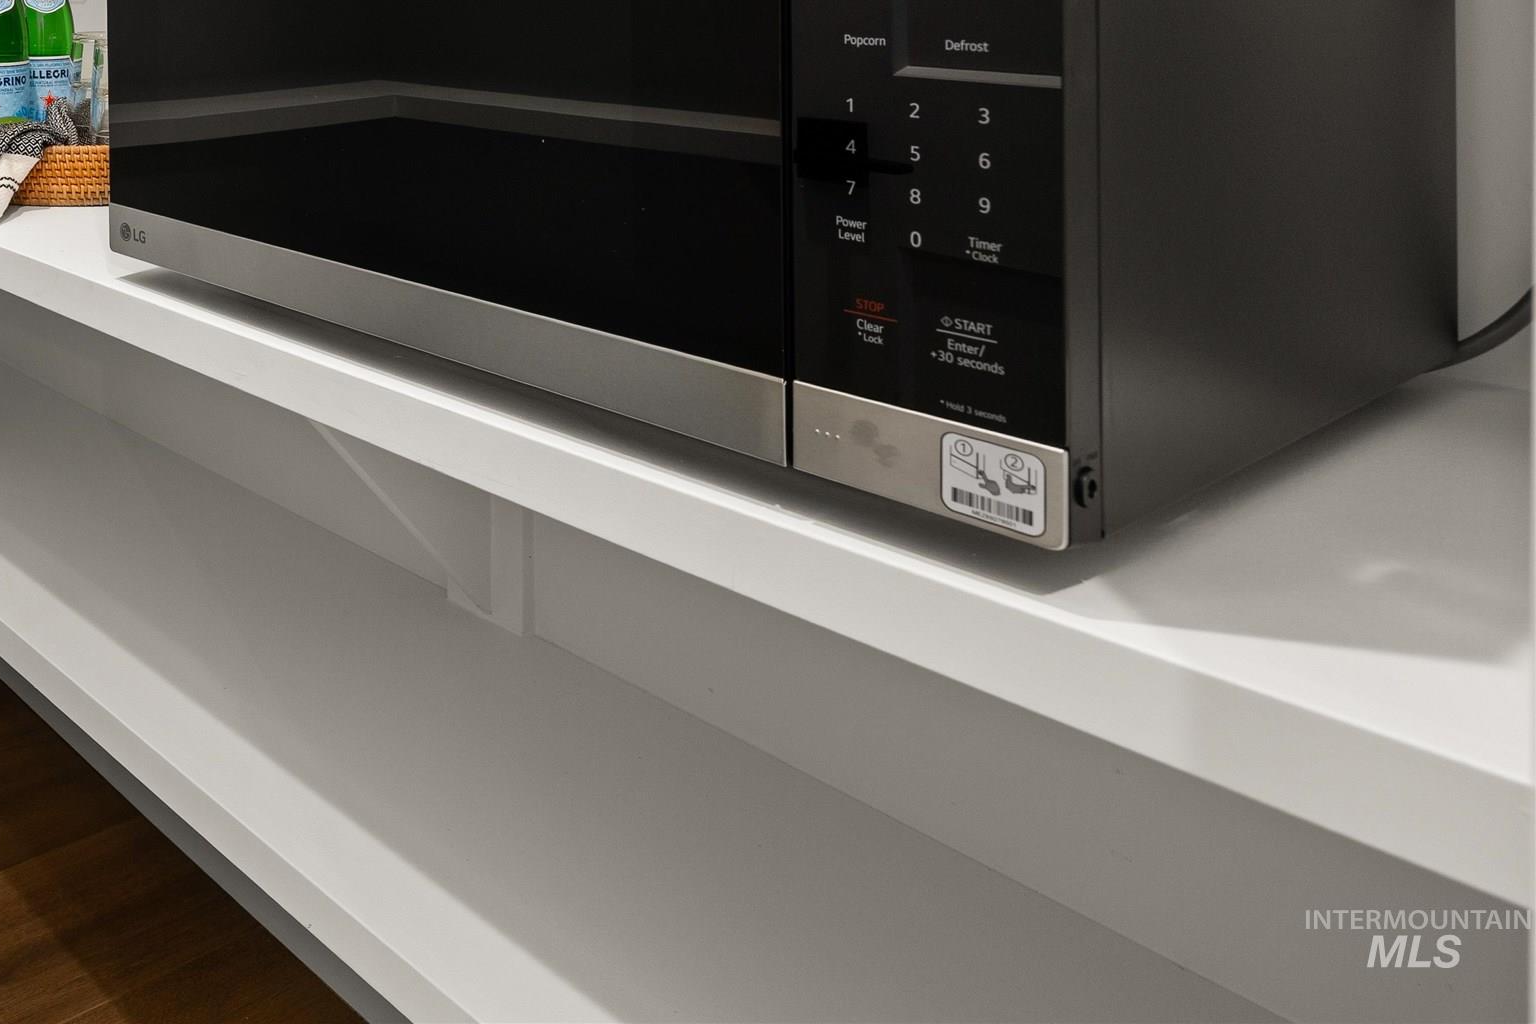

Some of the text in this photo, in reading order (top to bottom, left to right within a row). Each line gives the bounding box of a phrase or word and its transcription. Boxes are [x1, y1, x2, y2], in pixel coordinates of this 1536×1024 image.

[843, 33, 887, 48] Popcorn
[944, 39, 990, 53] Defrost
[845, 97, 855, 113] 1
[909, 102, 921, 119] 2
[977, 107, 991, 125] 3
[845, 139, 857, 155] 4
[909, 145, 921, 162] 5
[978, 152, 992, 170] 6
[846, 179, 857, 196] 7
[909, 188, 922, 205] 8
[978, 197, 991, 214] 9
[835, 215, 868, 230] Power
[133, 228, 146, 244] LG
[838, 228, 865, 243] Level
[909, 231, 923, 248] 0
[967, 236, 1003, 253] Timer
[971, 250, 999, 264] Clock
[855, 298, 885, 313] STOP
[856, 318, 884, 334] Clear
[953, 317, 994, 336] START
[863, 332, 884, 345] Lock
[947, 337, 986, 357] Enter/
[930, 349, 1006, 376] +30 seconds
[945, 400, 1007, 424] Hold 3 seconds
